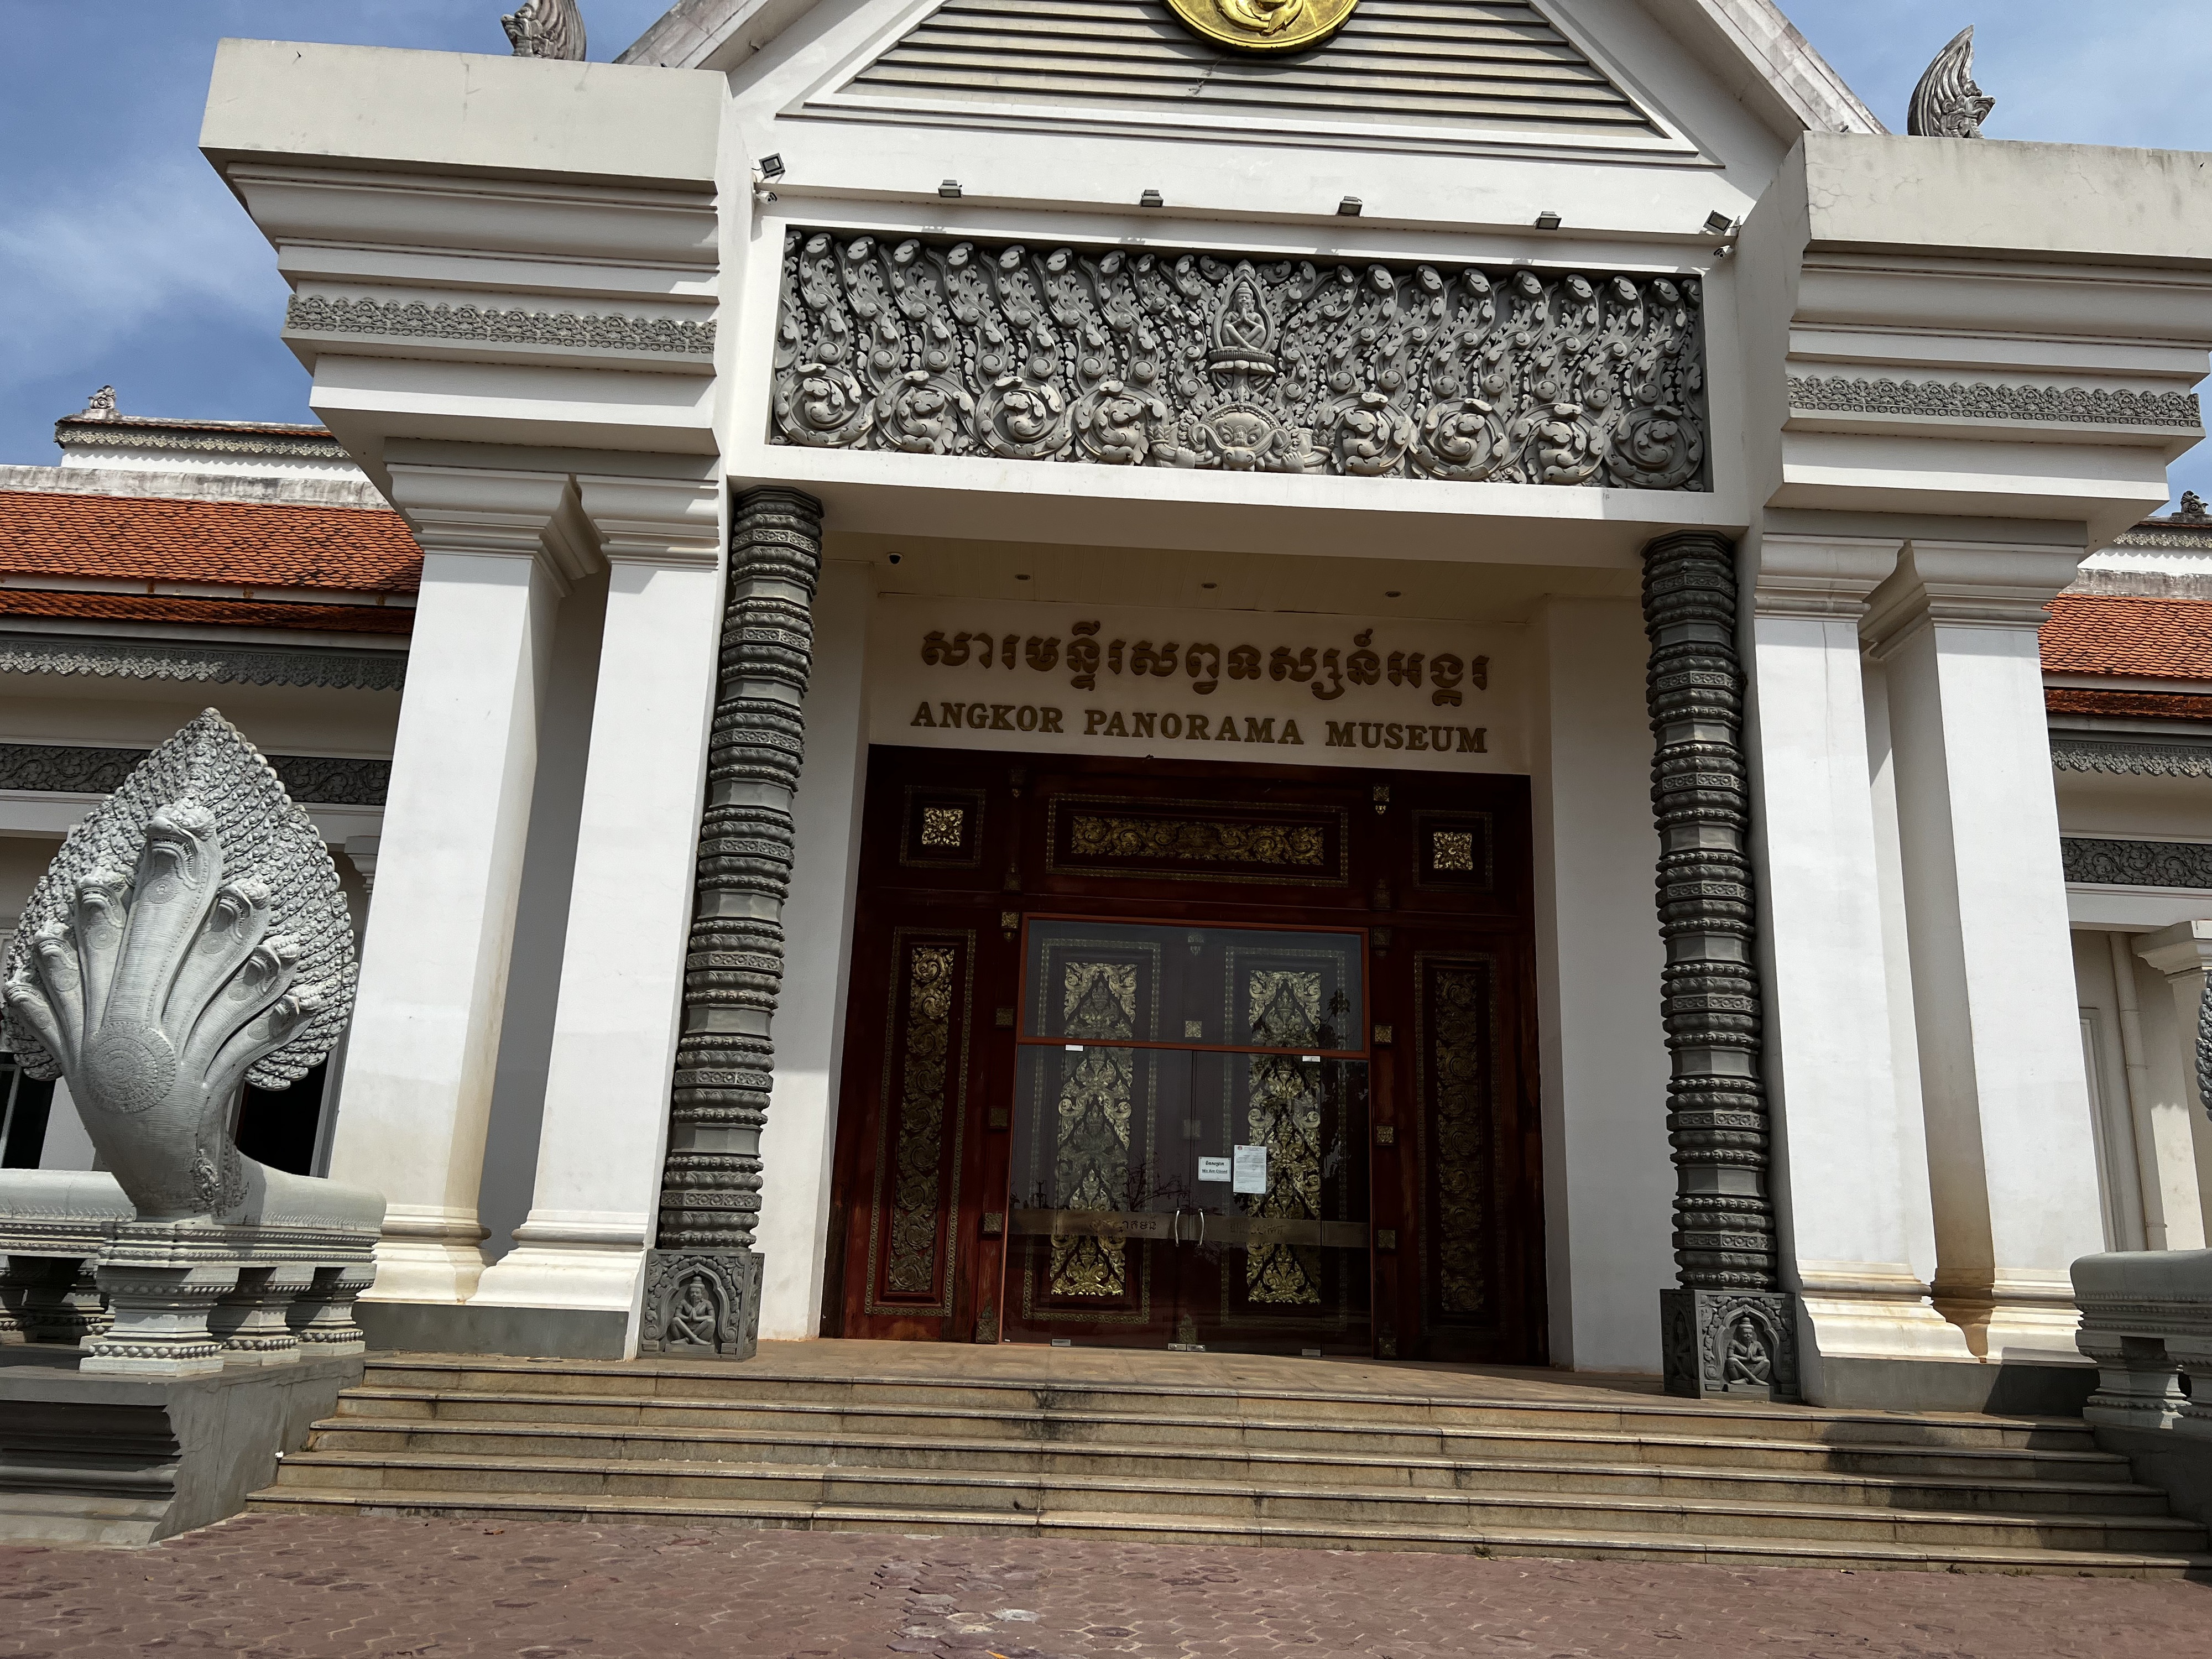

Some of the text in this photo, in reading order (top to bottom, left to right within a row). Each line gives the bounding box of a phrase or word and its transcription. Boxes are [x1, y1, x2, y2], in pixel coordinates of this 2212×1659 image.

[910, 702, 1488, 753] ANGKOR PANORAMA MUSEUM
